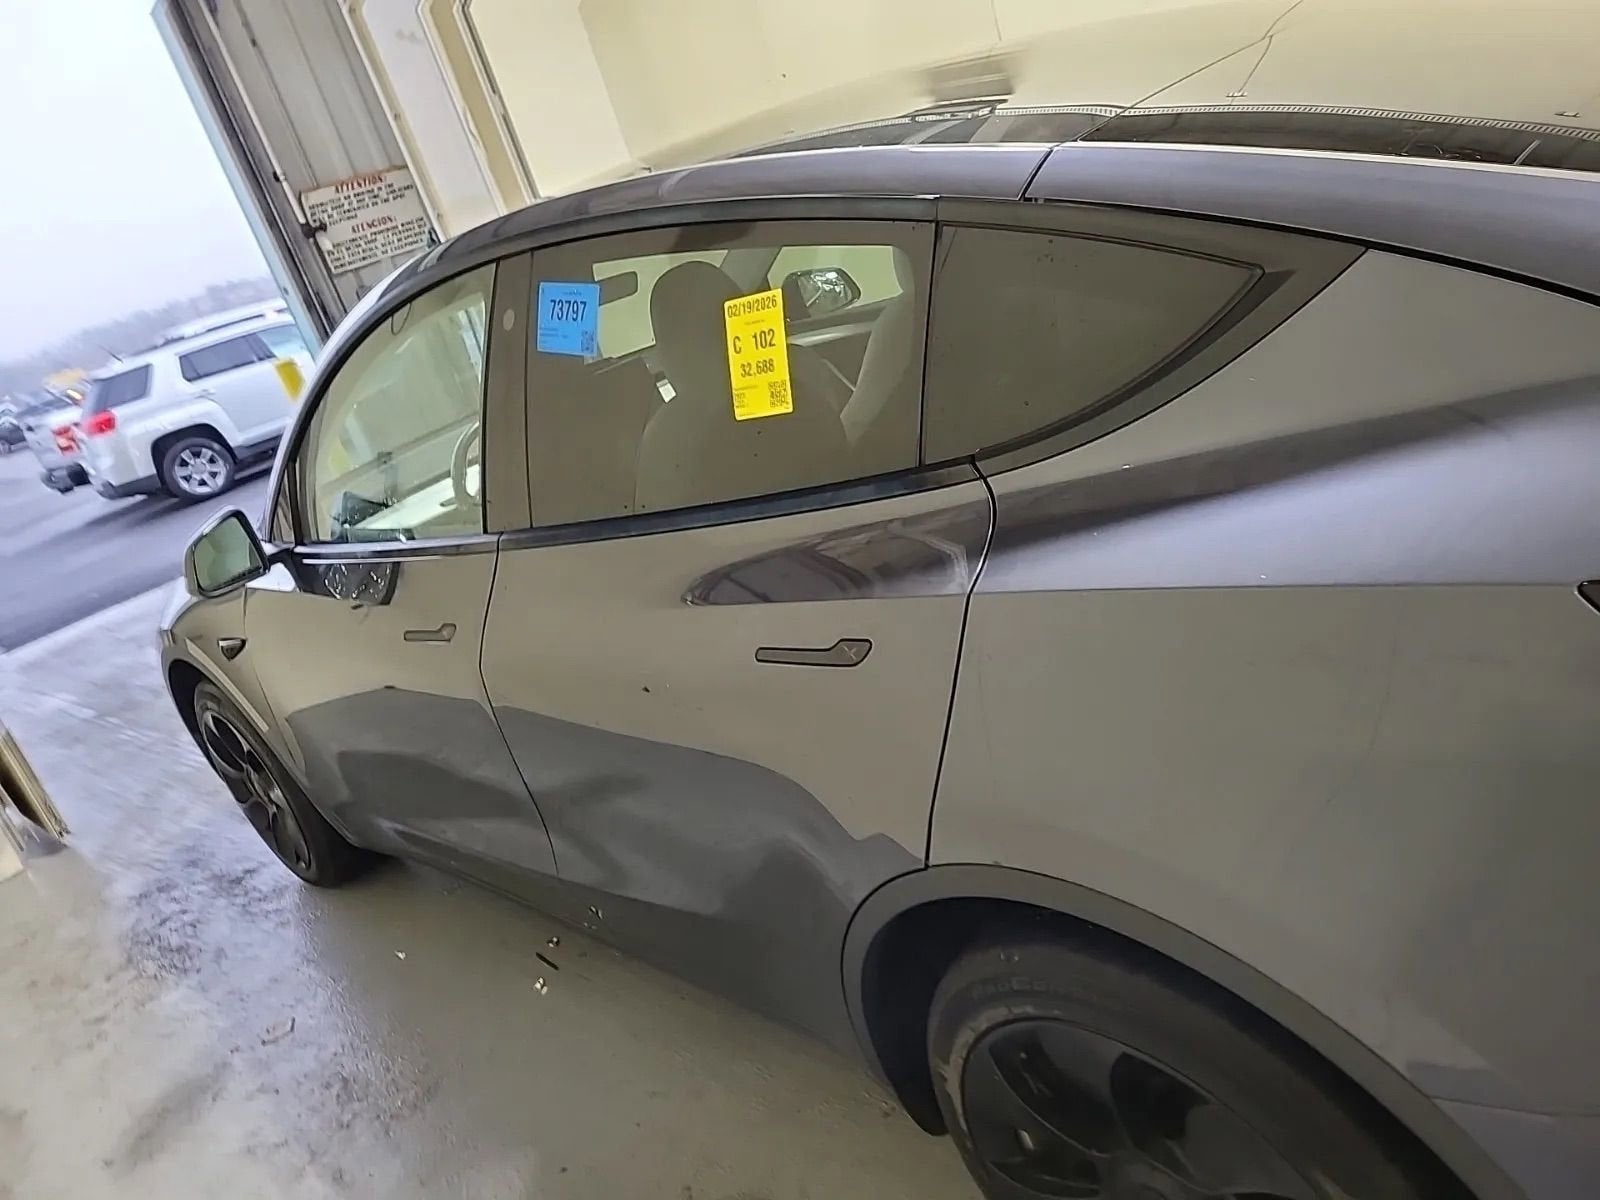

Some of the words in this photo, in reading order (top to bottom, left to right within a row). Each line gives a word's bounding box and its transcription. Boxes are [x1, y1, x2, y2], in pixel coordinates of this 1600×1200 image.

[549, 298, 588, 322] 73797
[727, 295, 777, 318] 02/19/2026
[732, 335, 742, 354] C
[752, 328, 776, 350] 102
